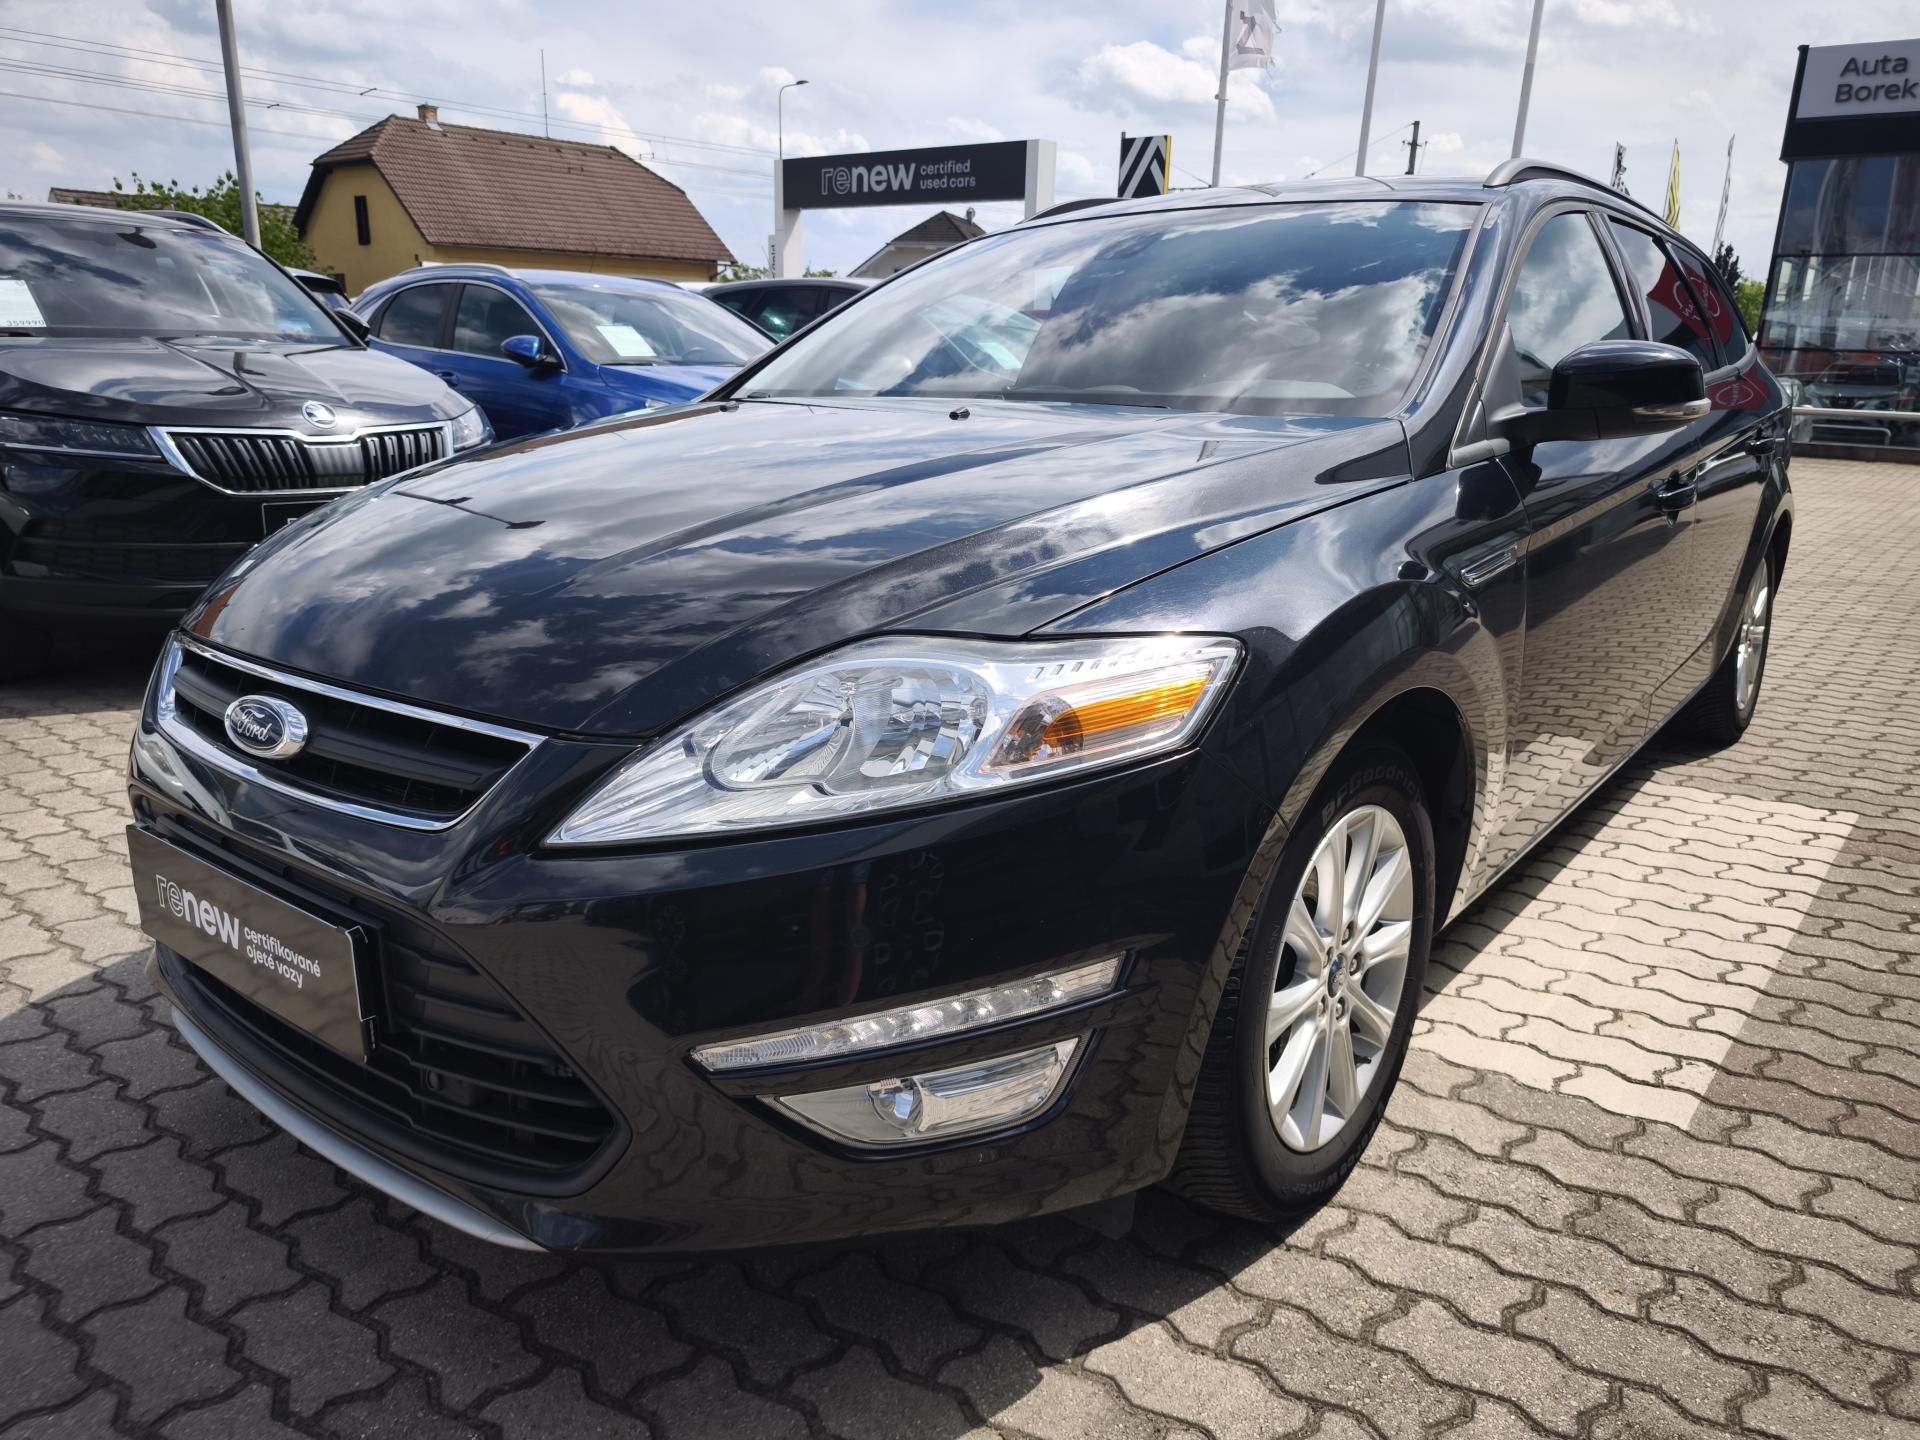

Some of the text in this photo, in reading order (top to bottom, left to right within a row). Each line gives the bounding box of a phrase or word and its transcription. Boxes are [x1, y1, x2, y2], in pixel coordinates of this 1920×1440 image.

[1840, 55, 1908, 77] Auta
[1835, 78, 1919, 102] Borek
[821, 163, 916, 195] renew
[920, 160, 971, 175] certified
[920, 176, 976, 189] used cars
[237, 708, 273, 741] Ford
[156, 874, 239, 949] renew
[244, 926, 321, 977] certifikované
[246, 944, 303, 989] ojeté vozy
